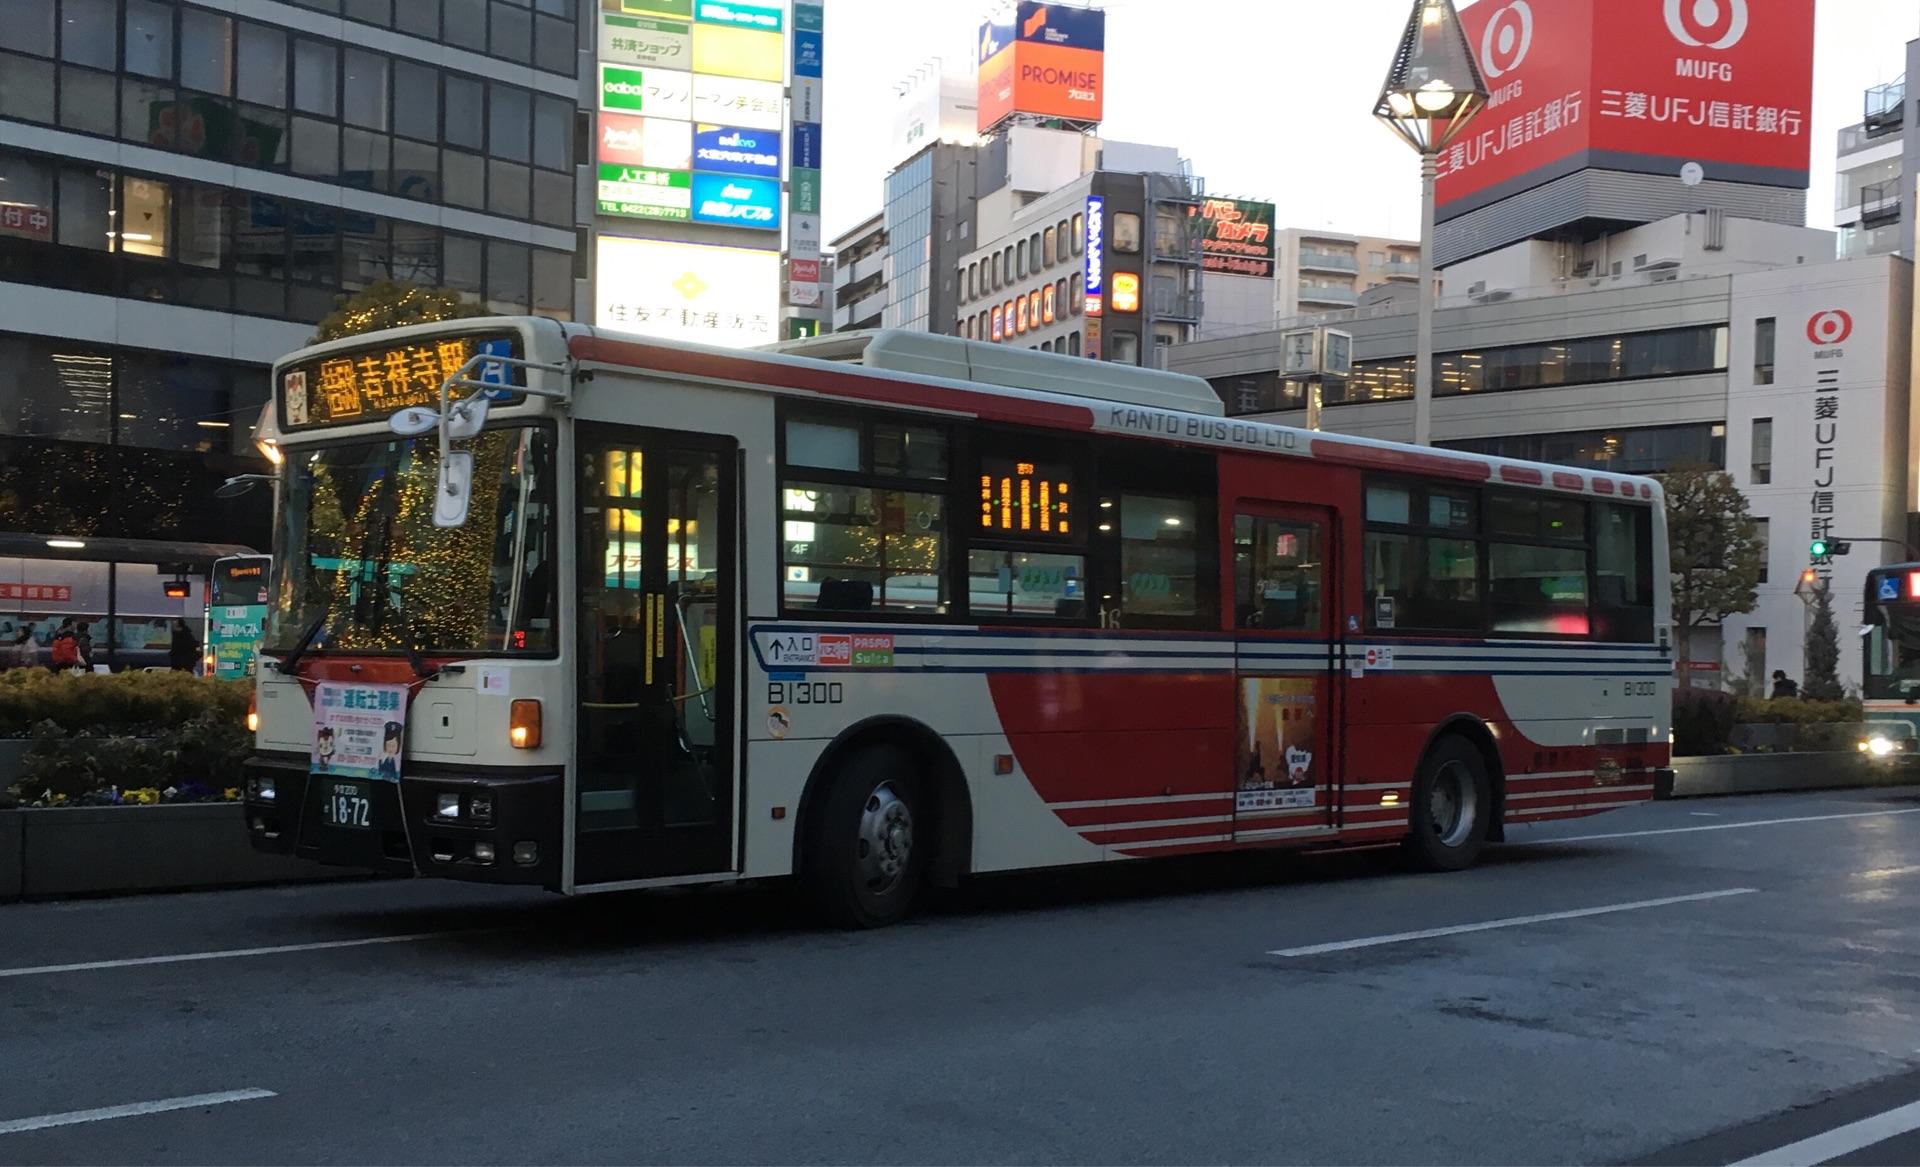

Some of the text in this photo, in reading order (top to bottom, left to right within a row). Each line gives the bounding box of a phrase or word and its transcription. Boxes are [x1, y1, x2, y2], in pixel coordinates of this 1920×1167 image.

[611, 37, 682, 57] 共済ショップ
[1022, 65, 1097, 90] PROMISE
[1675, 58, 1733, 82] MUFG
[1600, 89, 1802, 136] 三菱UFJ信託銀行
[1436, 90, 1582, 180] 三菱UFJ信託銀行
[1110, 406, 1180, 434] KANTO
[1186, 417, 1227, 441] BUS
[1810, 369, 1840, 588] 三菱UFJ信託
[791, 543, 808, 555] 4F
[787, 637, 813, 652] 入口
[853, 638, 891, 650] PASMO
[855, 653, 889, 665] Suica
[768, 682, 843, 704] B1300
